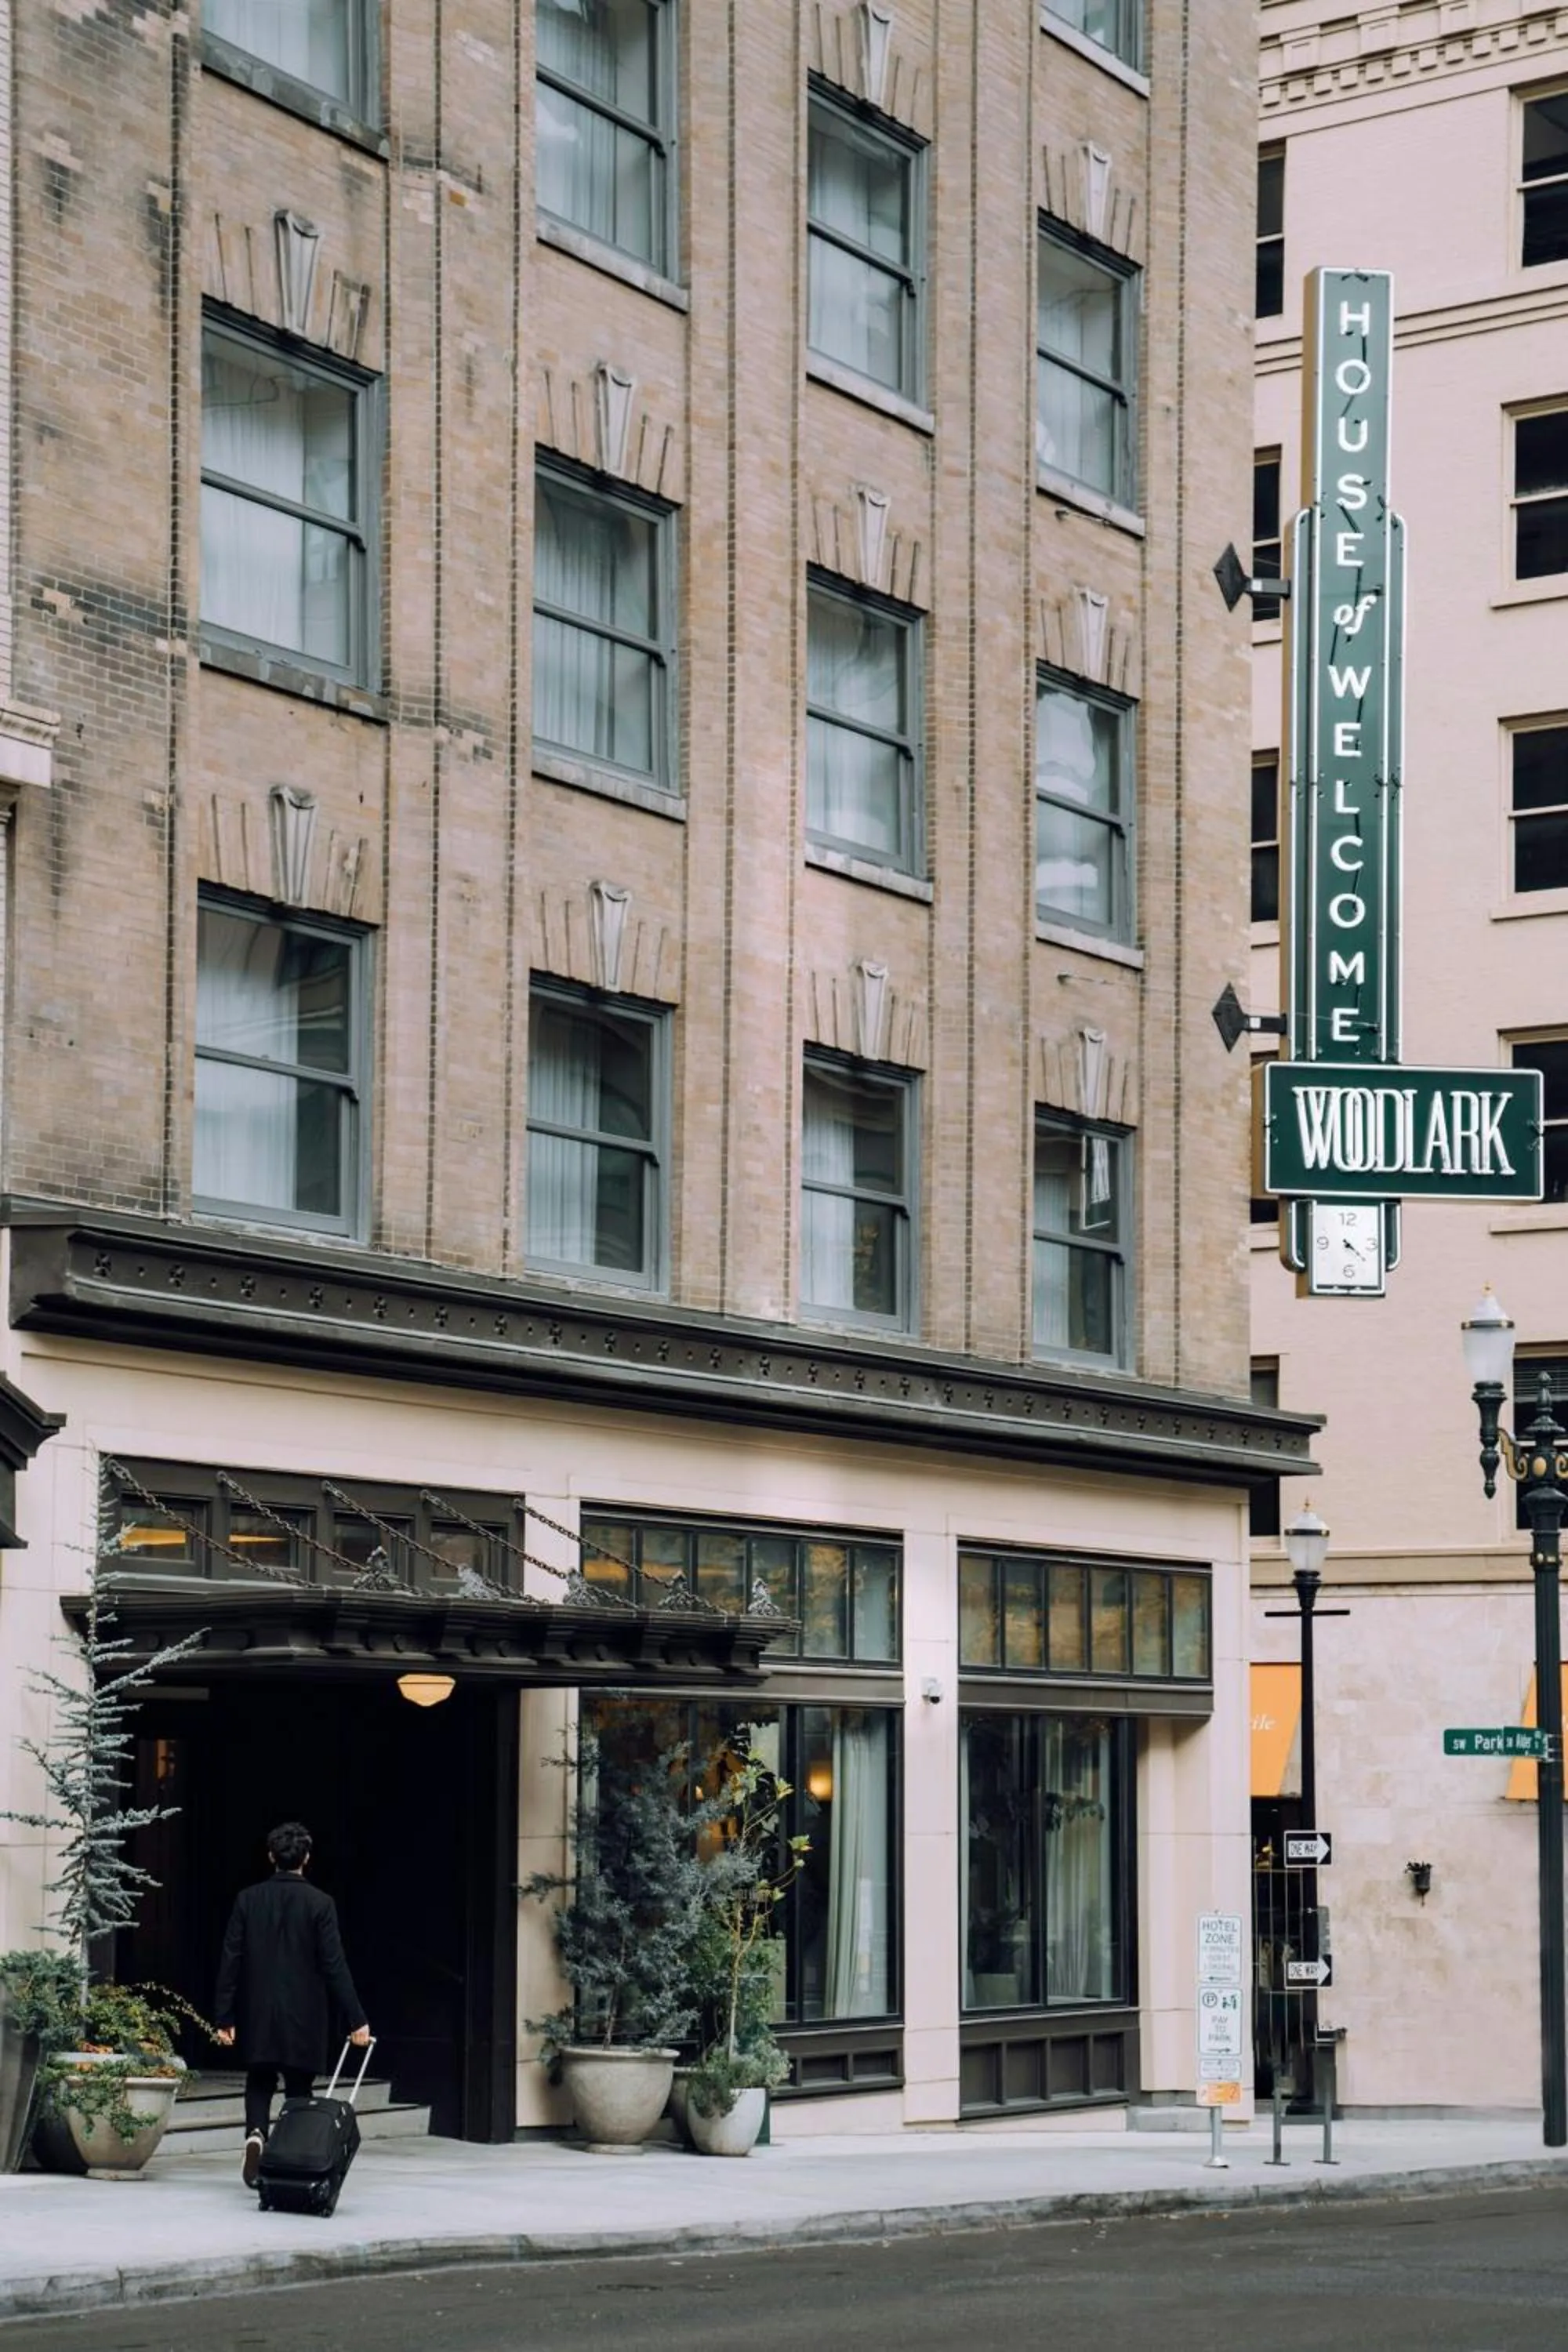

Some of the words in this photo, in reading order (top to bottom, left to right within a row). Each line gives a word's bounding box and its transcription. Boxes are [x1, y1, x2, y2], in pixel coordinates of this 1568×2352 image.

[1334, 300, 1371, 568] HOUSE
[1333, 594, 1377, 635] of
[1329, 664, 1371, 1042] WELCOME
[1291, 1086, 1517, 1176] WOODLARK
[1338, 1212, 1358, 1228] 12
[1316, 1236, 1330, 1250] 9
[1365, 1237, 1378, 1252] 3
[1342, 1264, 1356, 1279] 6
[1475, 1733, 1504, 1750] Park
[1290, 1842, 1302, 1856] ONE
[1304, 1842, 1318, 1855] WAY
[1202, 1919, 1238, 1933] HOTEL
[1205, 1932, 1236, 1944] ZONE
[1290, 1964, 1303, 1977] ONE
[1305, 1964, 1318, 1976] WAY
